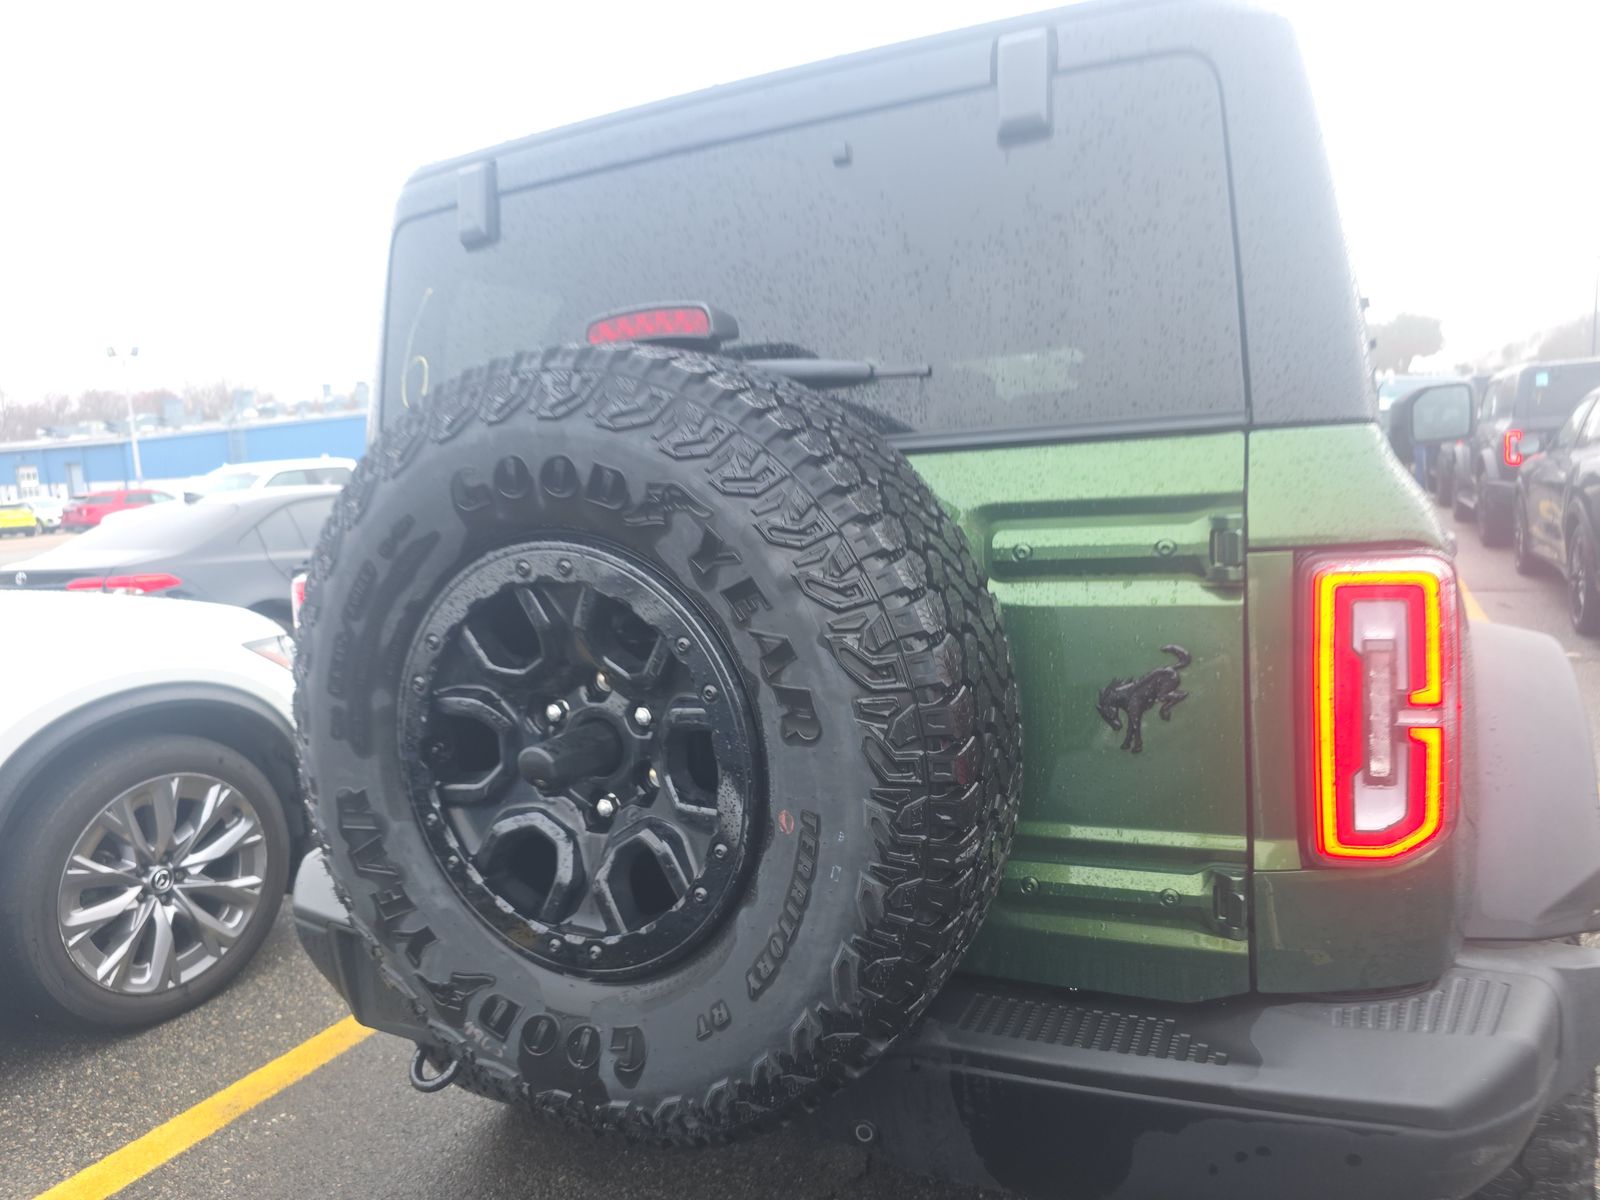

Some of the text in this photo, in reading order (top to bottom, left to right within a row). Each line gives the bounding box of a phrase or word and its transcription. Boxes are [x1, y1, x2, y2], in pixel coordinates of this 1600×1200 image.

[452, 455, 822, 746] GOODYEAR
[337, 788, 647, 1075] GOODYEAR
[696, 808, 821, 1041] TERRITORY RT
